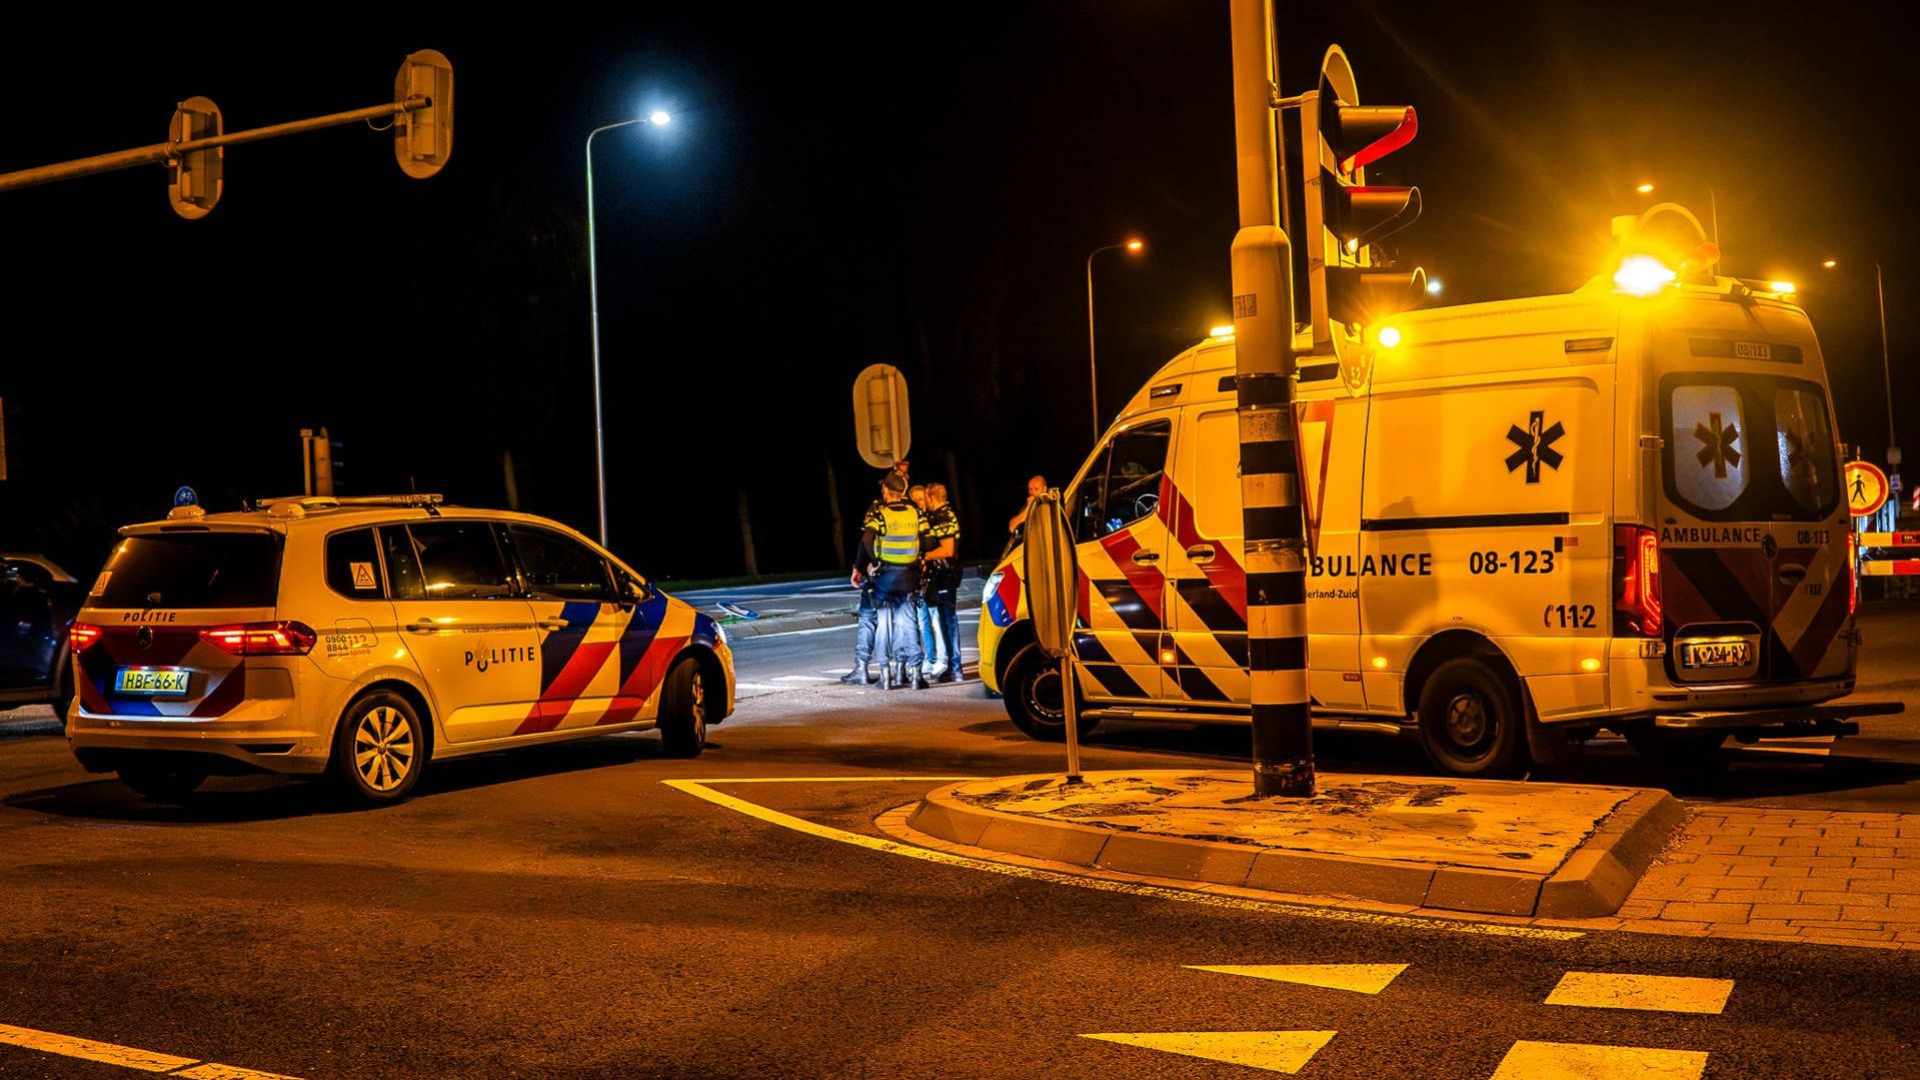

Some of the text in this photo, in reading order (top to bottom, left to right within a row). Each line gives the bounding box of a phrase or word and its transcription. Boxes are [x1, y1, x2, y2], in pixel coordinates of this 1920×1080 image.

[1661, 528, 1761, 542] AMBULANCE
[1304, 553, 1432, 577] BULANCE
[1470, 550, 1554, 574] 08-123
[1307, 588, 1358, 598] erland-Zuid
[123, 612, 177, 622] POLITIE
[325, 635, 347, 643] 0900
[326, 644, 348, 652] 8844
[465, 647, 535, 673] POLITIE
[125, 673, 184, 690] HBF-66-K
